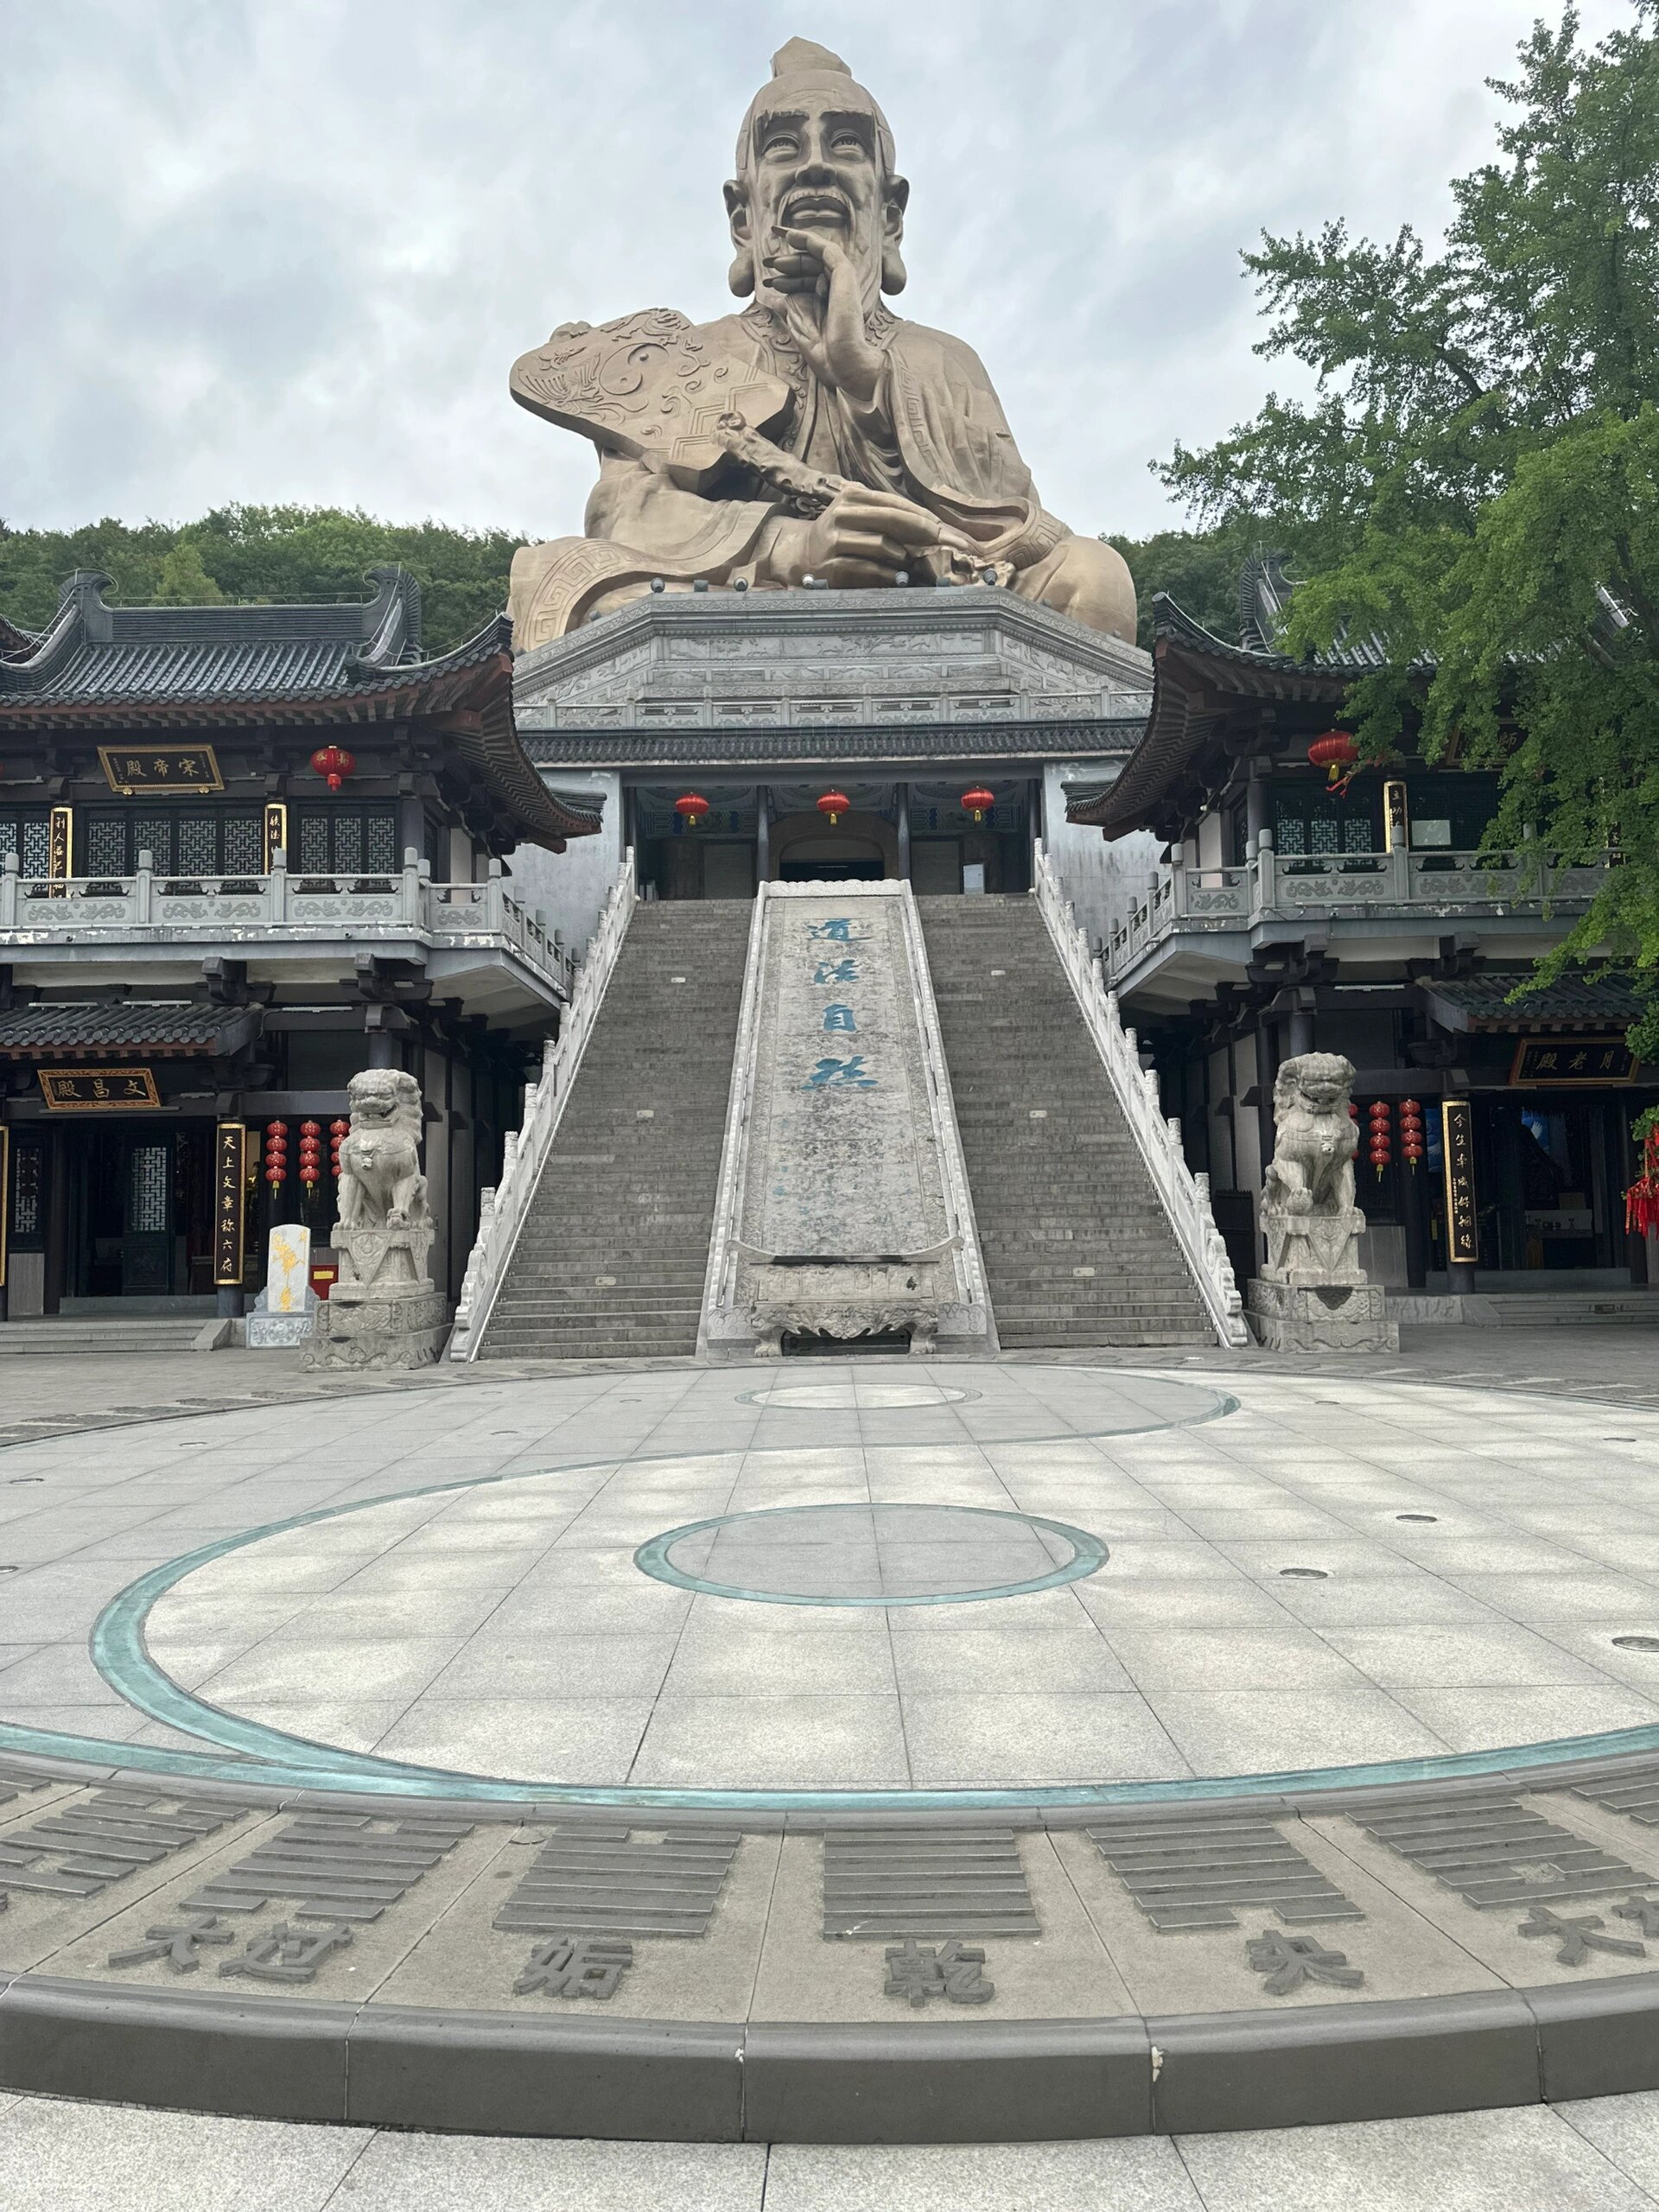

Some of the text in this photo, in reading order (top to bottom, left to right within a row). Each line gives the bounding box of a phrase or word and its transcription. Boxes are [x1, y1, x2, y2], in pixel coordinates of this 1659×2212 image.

[125, 758, 200, 778] 宋帝殿
[801, 918, 879, 1091] 道法自然
[57, 1077, 147, 1099] 文昌殿
[1535, 1050, 1615, 1071] 月老殿
[512, 1936, 633, 2000] 姤
[883, 1940, 995, 2008] 乾
[1245, 1929, 1364, 1997] 夬
